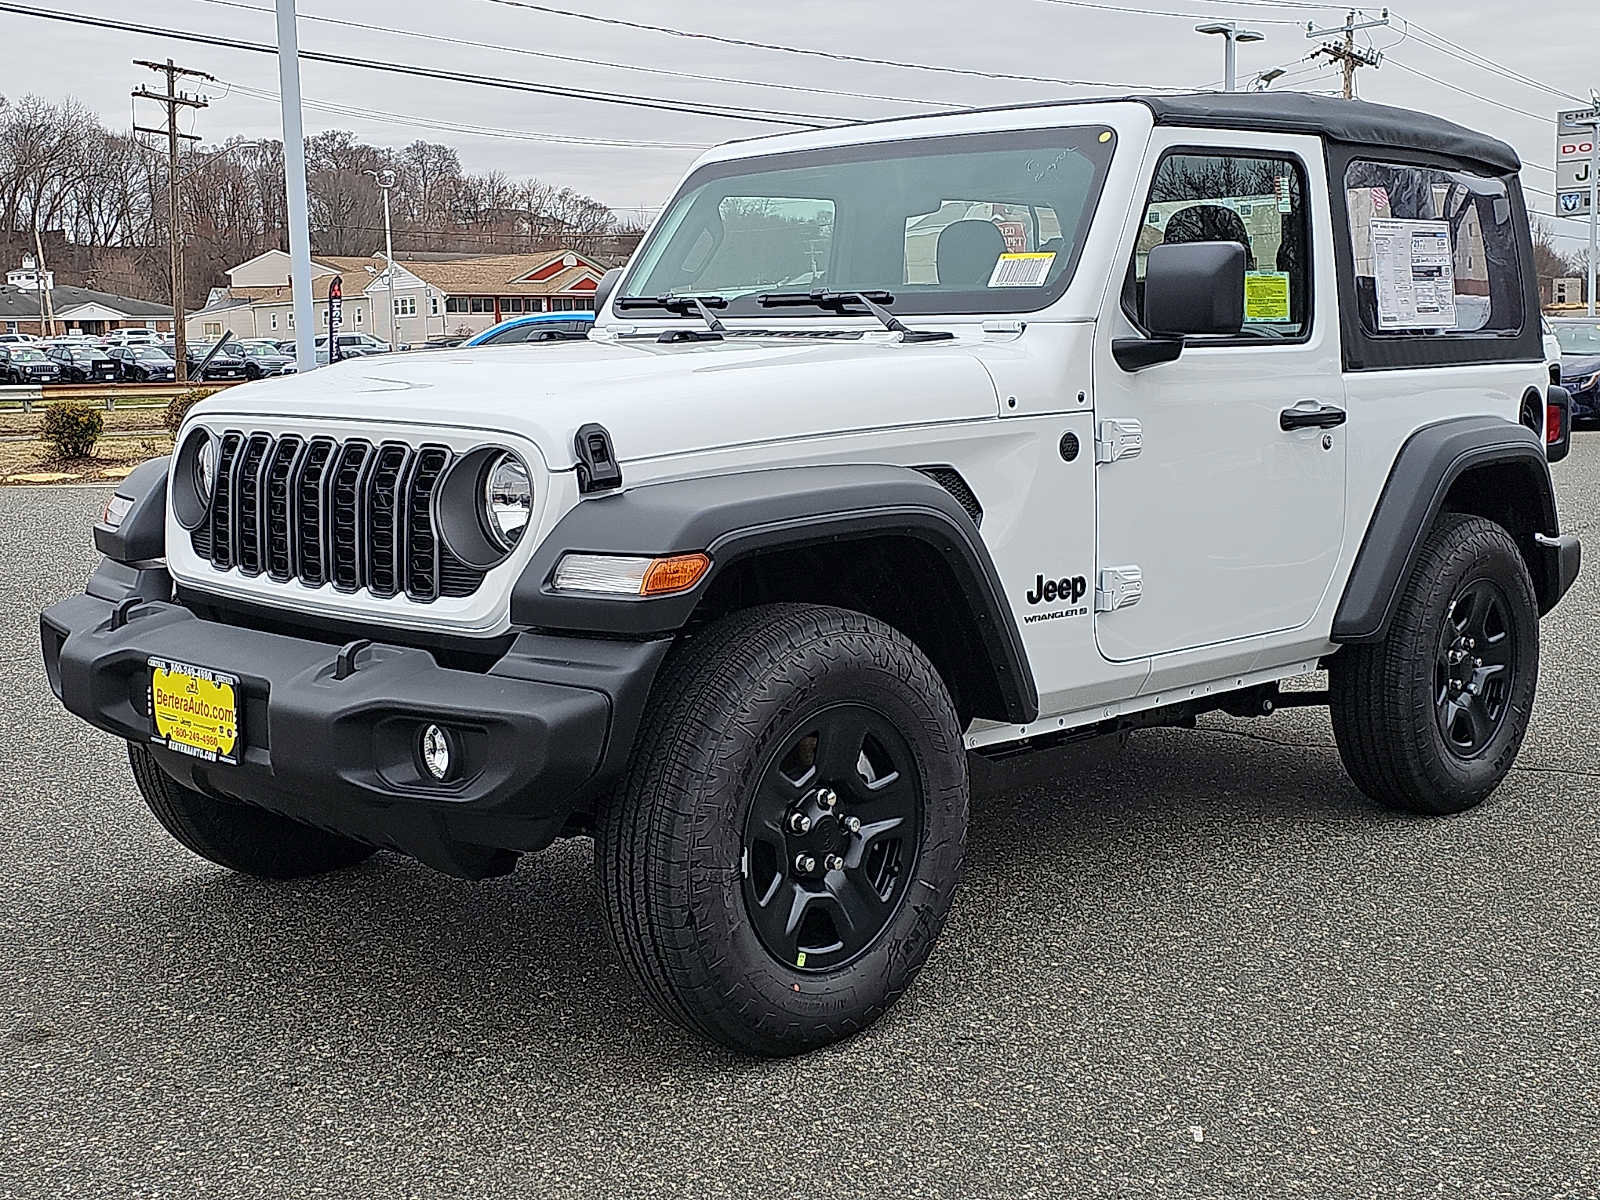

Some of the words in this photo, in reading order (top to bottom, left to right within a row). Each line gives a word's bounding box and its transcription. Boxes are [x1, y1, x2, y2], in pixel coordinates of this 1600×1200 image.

[1562, 142, 1600, 154] DO
[1026, 574, 1087, 605] Jeep
[1023, 608, 1078, 624] WRANGLER
[156, 688, 234, 723] BerteraAuto.com
